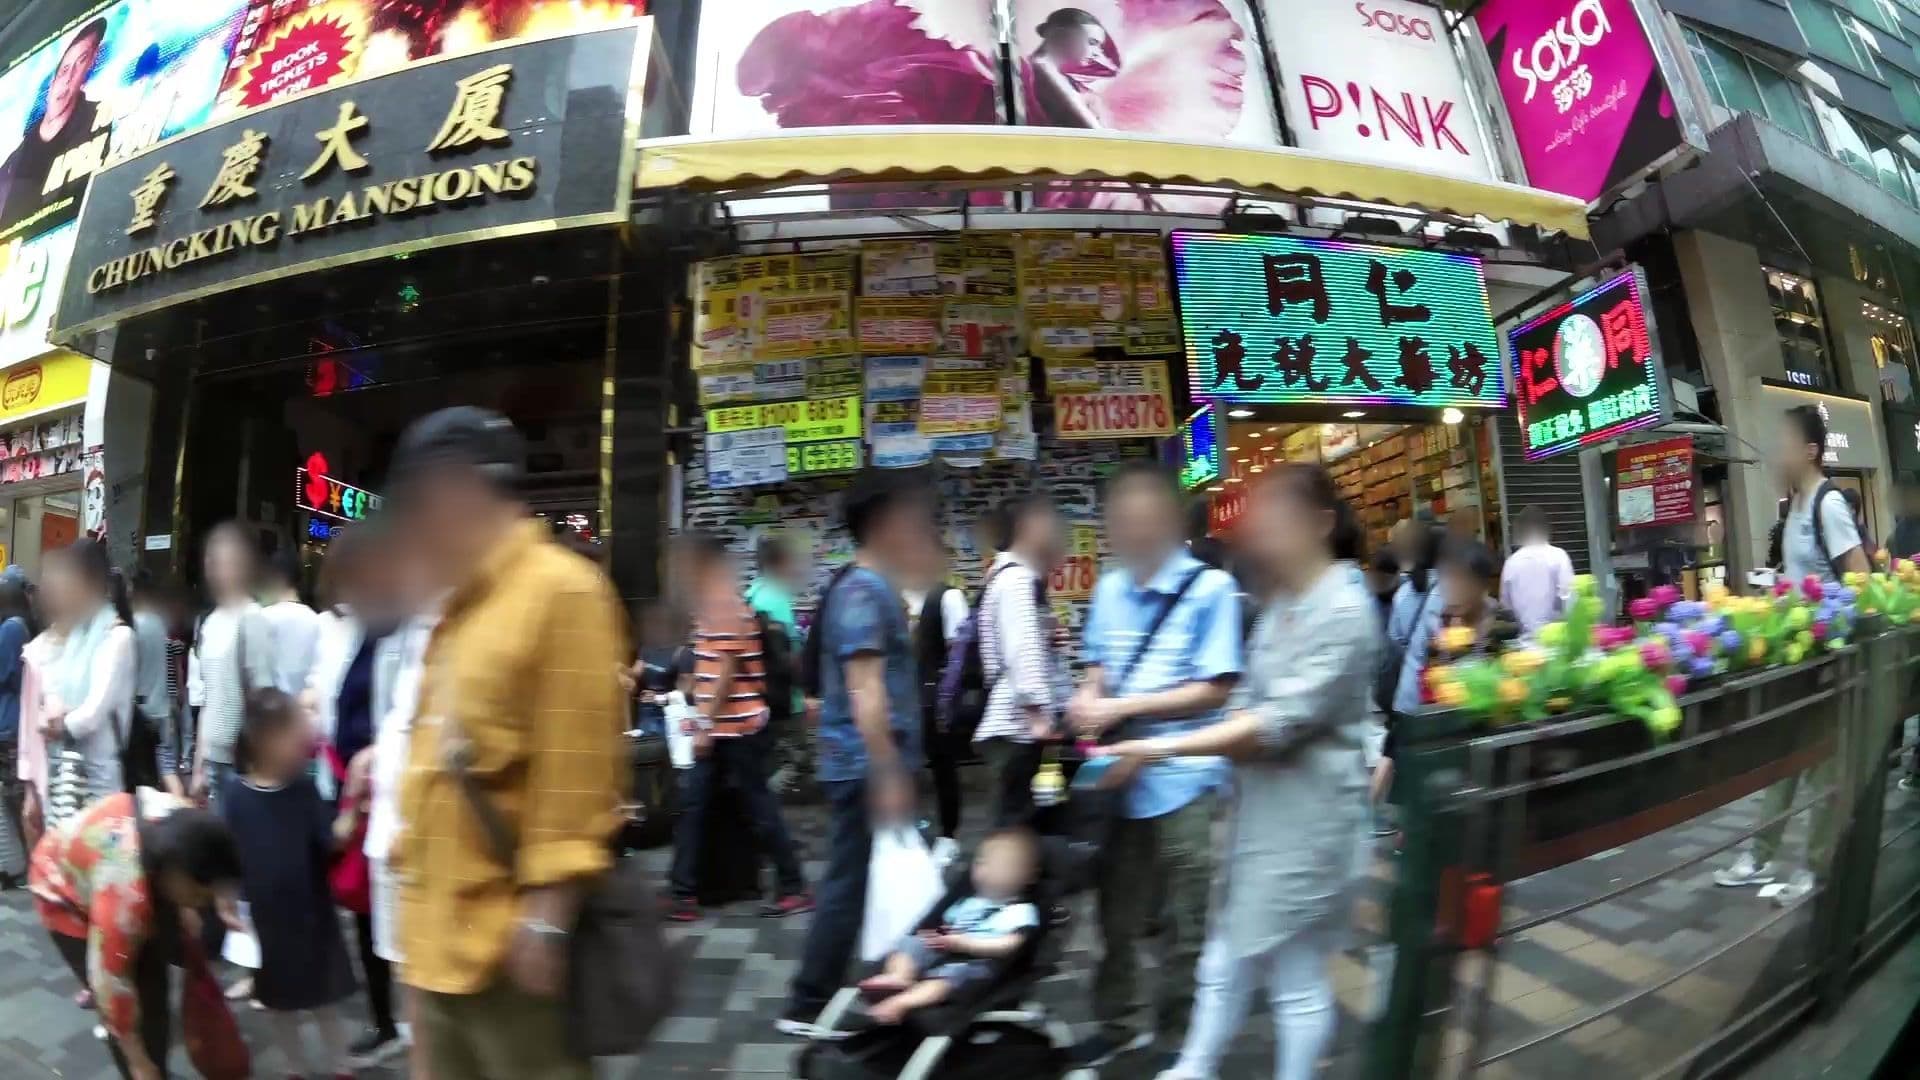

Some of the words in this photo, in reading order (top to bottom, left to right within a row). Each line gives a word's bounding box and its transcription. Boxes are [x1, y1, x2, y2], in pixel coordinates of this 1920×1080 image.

[1355, 2, 1436, 43] sasa
[260, 52, 328, 94] TICKETS
[271, 40, 320, 74] BOOK
[1512, 0, 1612, 104] sasa
[87, 211, 279, 295] CHUNGKING
[288, 156, 537, 237] MANSIONS
